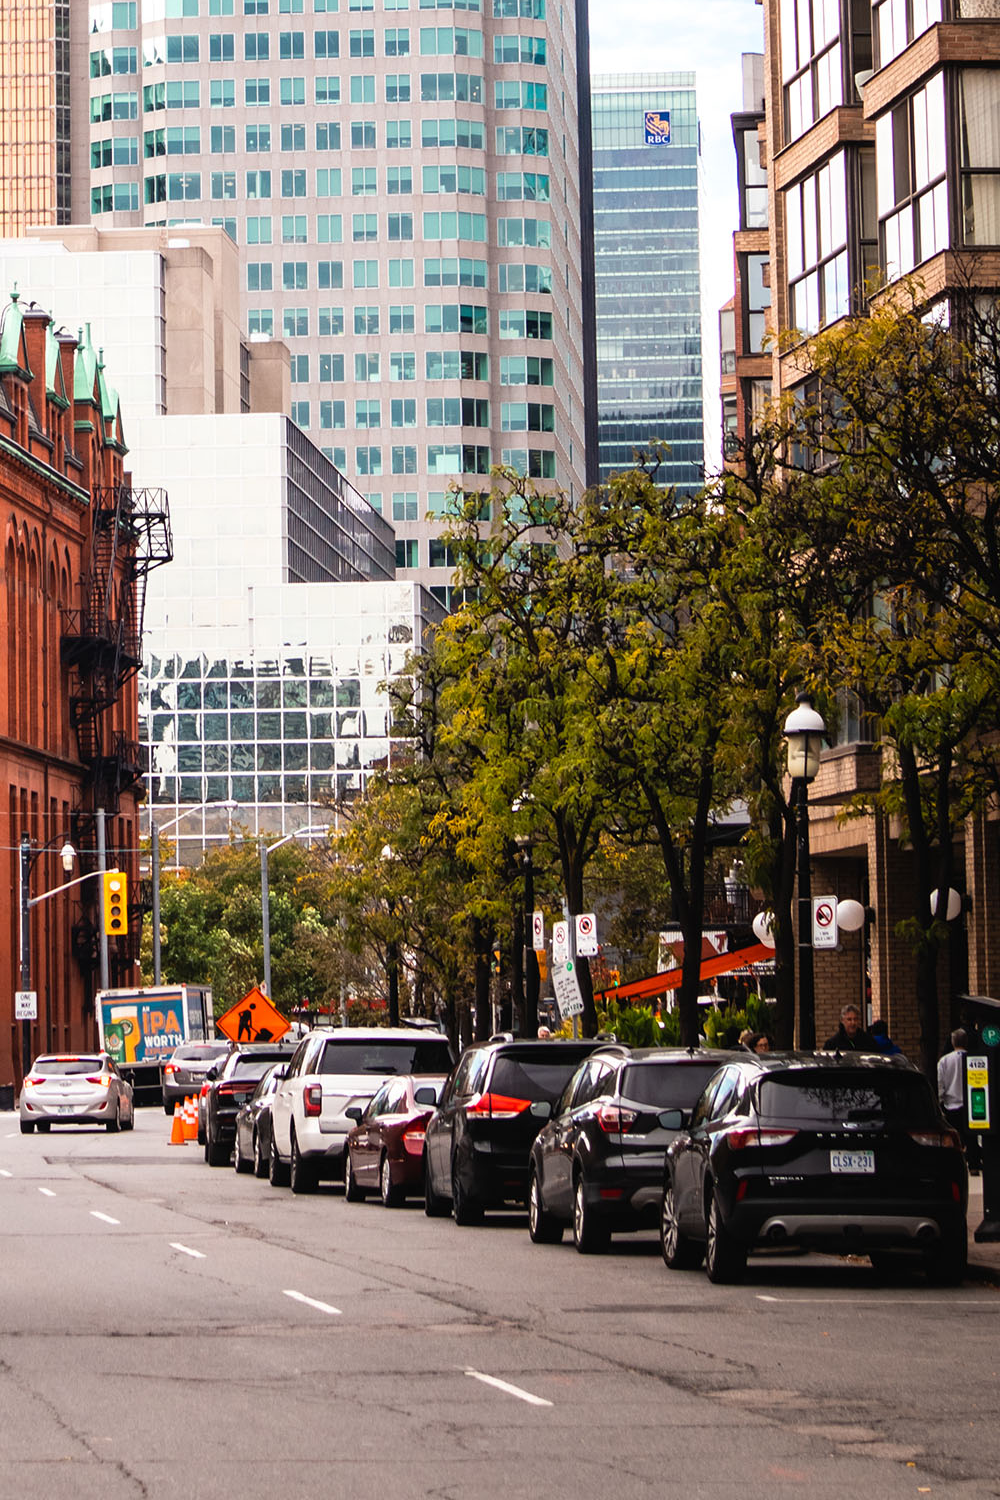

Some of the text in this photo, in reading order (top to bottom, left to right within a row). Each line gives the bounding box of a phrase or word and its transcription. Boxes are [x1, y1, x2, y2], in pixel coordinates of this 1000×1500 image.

[647, 135, 668, 144] RBC
[142, 1010, 181, 1035] IPA
[988, 1030, 995, 1039] P
[144, 1034, 183, 1048] WORTH
